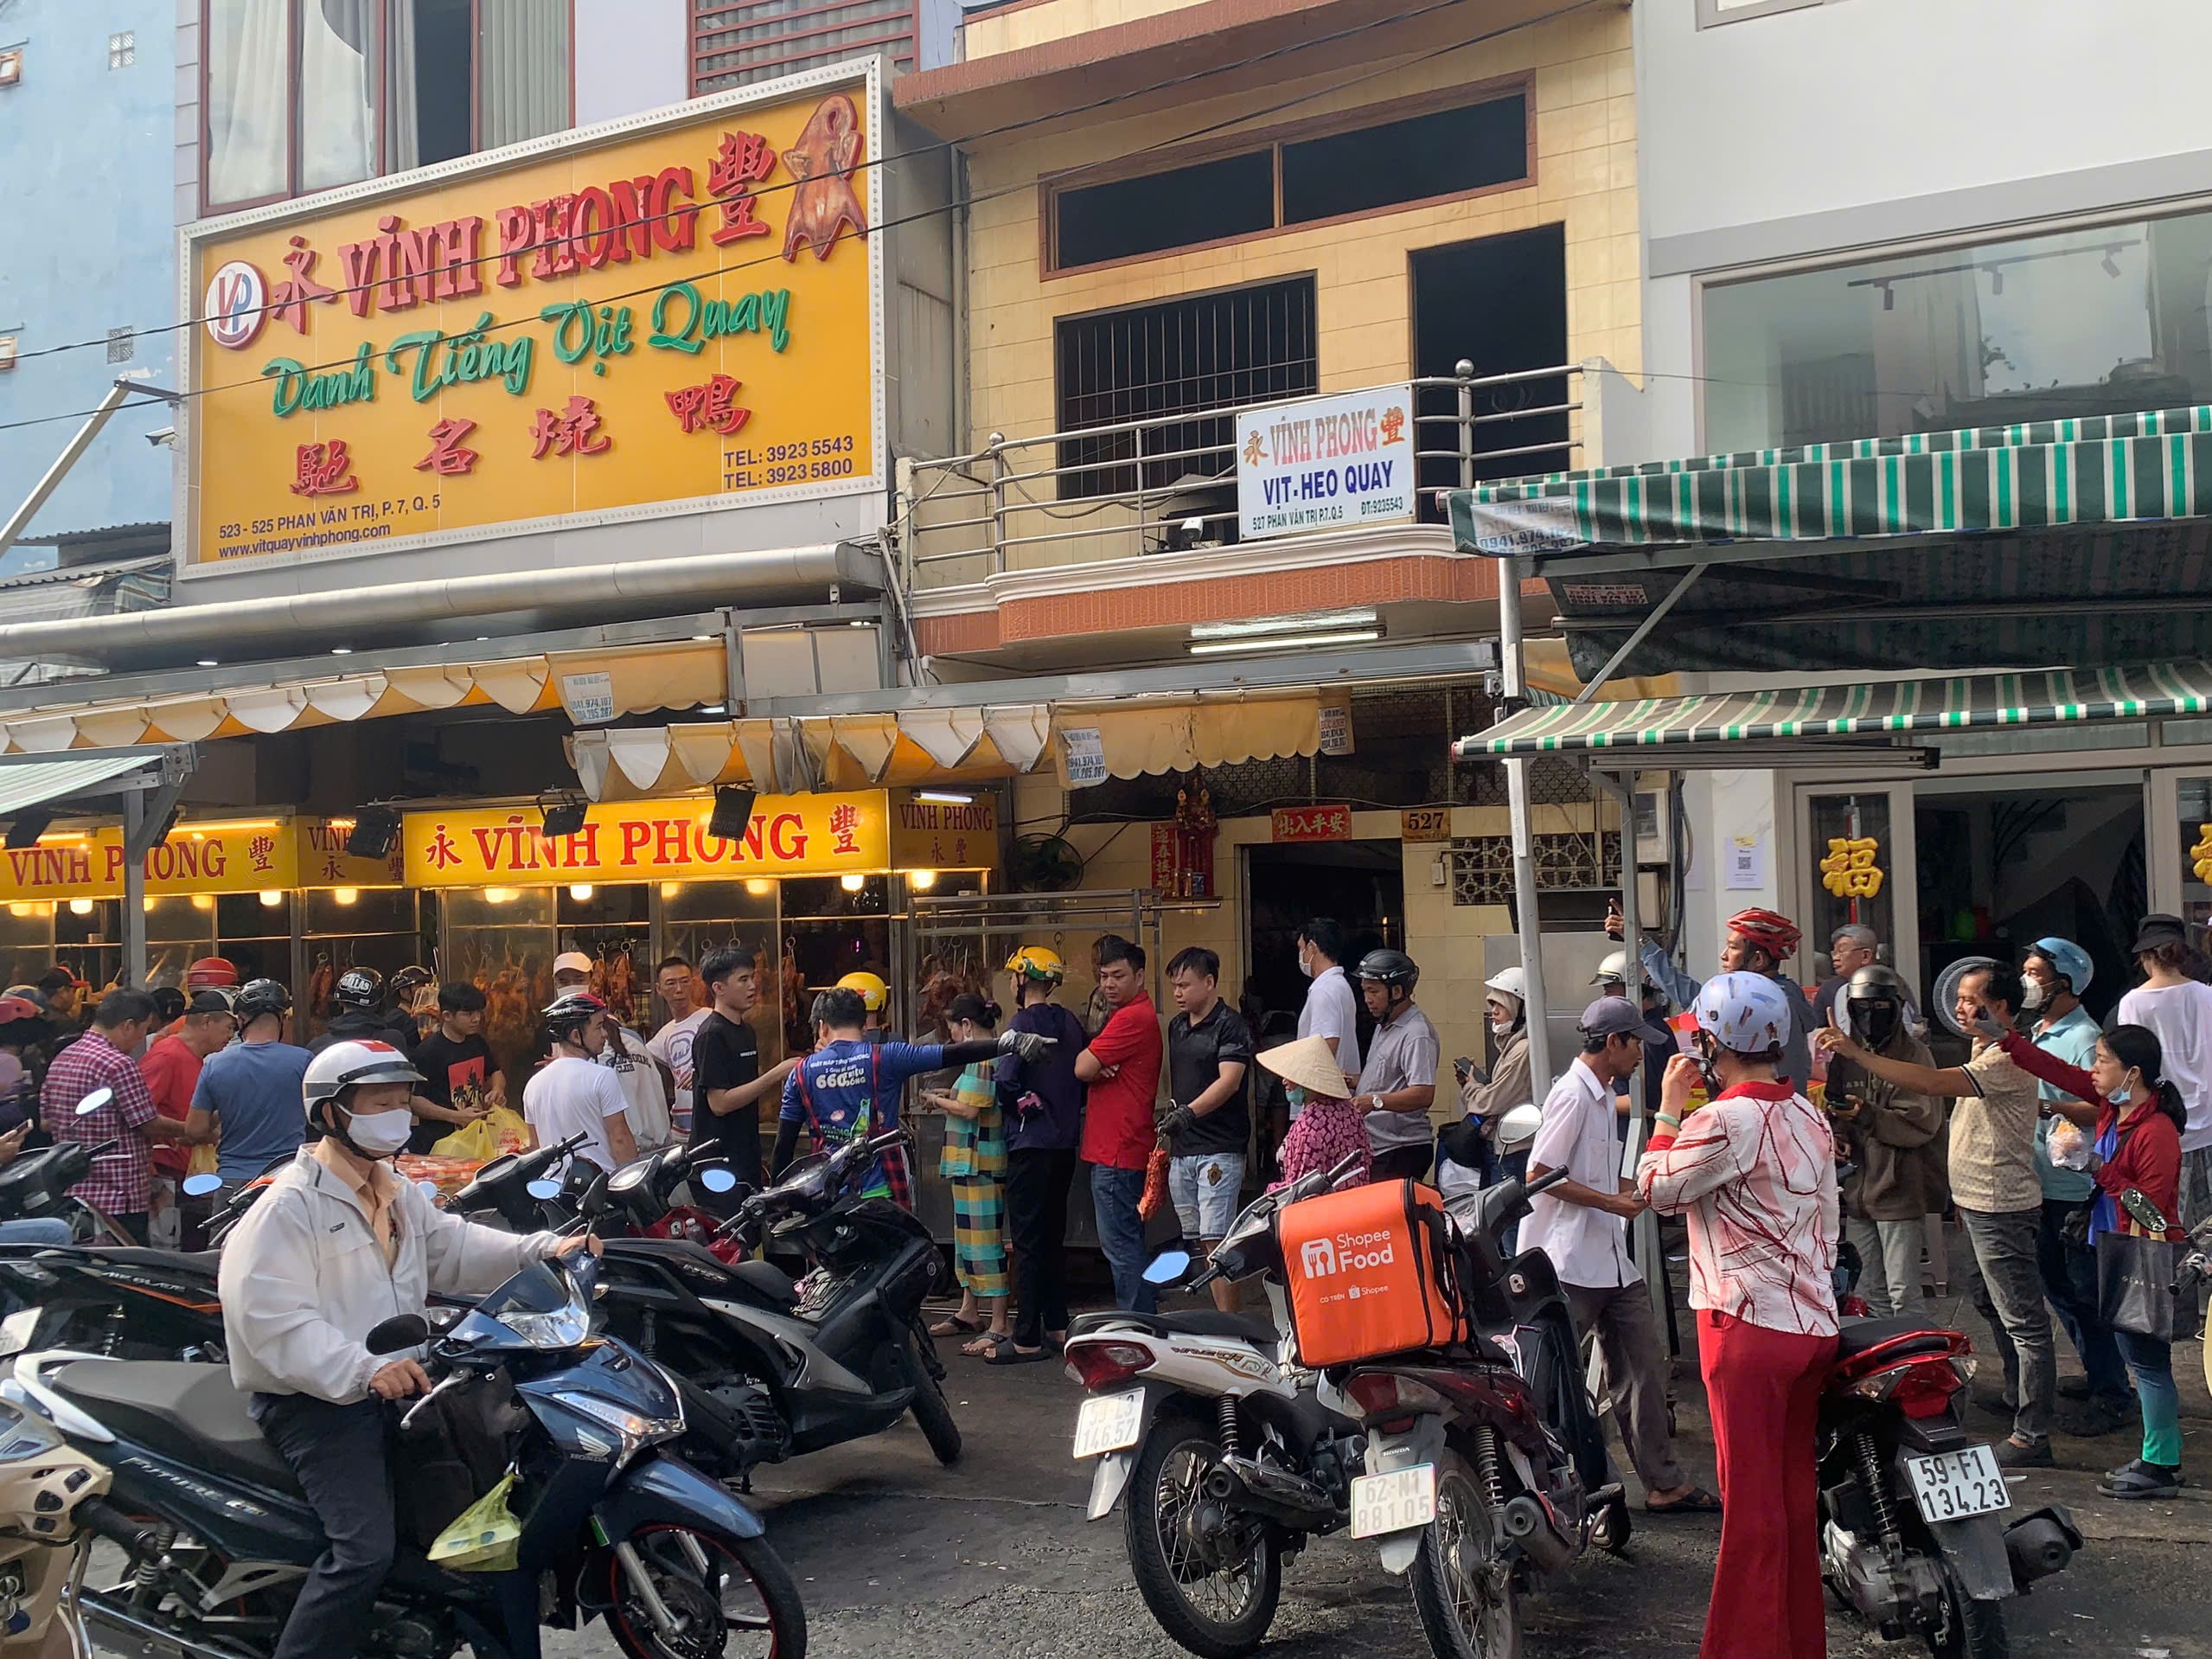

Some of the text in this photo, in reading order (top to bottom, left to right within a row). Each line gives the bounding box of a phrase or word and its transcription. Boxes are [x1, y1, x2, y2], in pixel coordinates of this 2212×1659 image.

[706, 131, 777, 246] 豐
[495, 165, 700, 289] PHONG
[272, 235, 338, 335] 永
[261, 279, 791, 418] Danh Tiếng Vịt Quay
[1315, 407, 1378, 460] PHONG
[724, 435, 853, 468] TEL: 3923 5543
[724, 458, 853, 490] TEL: 3923 5800
[1345, 460, 1394, 495] QUAY
[219, 523, 241, 538] 523
[252, 519, 274, 534] 525
[277, 512, 316, 530] PHAN
[320, 505, 348, 524] VĂN
[412, 496, 429, 511] Q.
[432, 494, 440, 509] 5
[1252, 516, 1265, 531] 527
[1267, 512, 1288, 528] PHAN
[218, 524, 391, 558] www.vitquayvinhphong.com
[830, 804, 860, 854] 豐
[943, 805, 992, 830] PHONG
[1279, 812, 1345, 836] 出入平安
[1408, 811, 1444, 831] 527
[248, 836, 274, 872] 豐
[425, 824, 463, 870] 永
[471, 813, 808, 870] VĨNH PHONG
[321, 855, 346, 881] 永
[1819, 837, 1883, 898] 福
[815, 1073, 847, 1089] 660
[1336, 1230, 1391, 1249] Shopee
[1339, 1242, 1394, 1272] Food
[1361, 1284, 1389, 1296] Shopee
[570, 1453, 609, 1463] HONDA
[1383, 1446, 1410, 1457] HONDA
[1920, 1450, 1985, 1486] 59-F1
[1365, 1471, 1419, 1503] 62-N1
[1921, 1478, 2005, 1519] 134.23
[1358, 1496, 1429, 1531] 881.05
